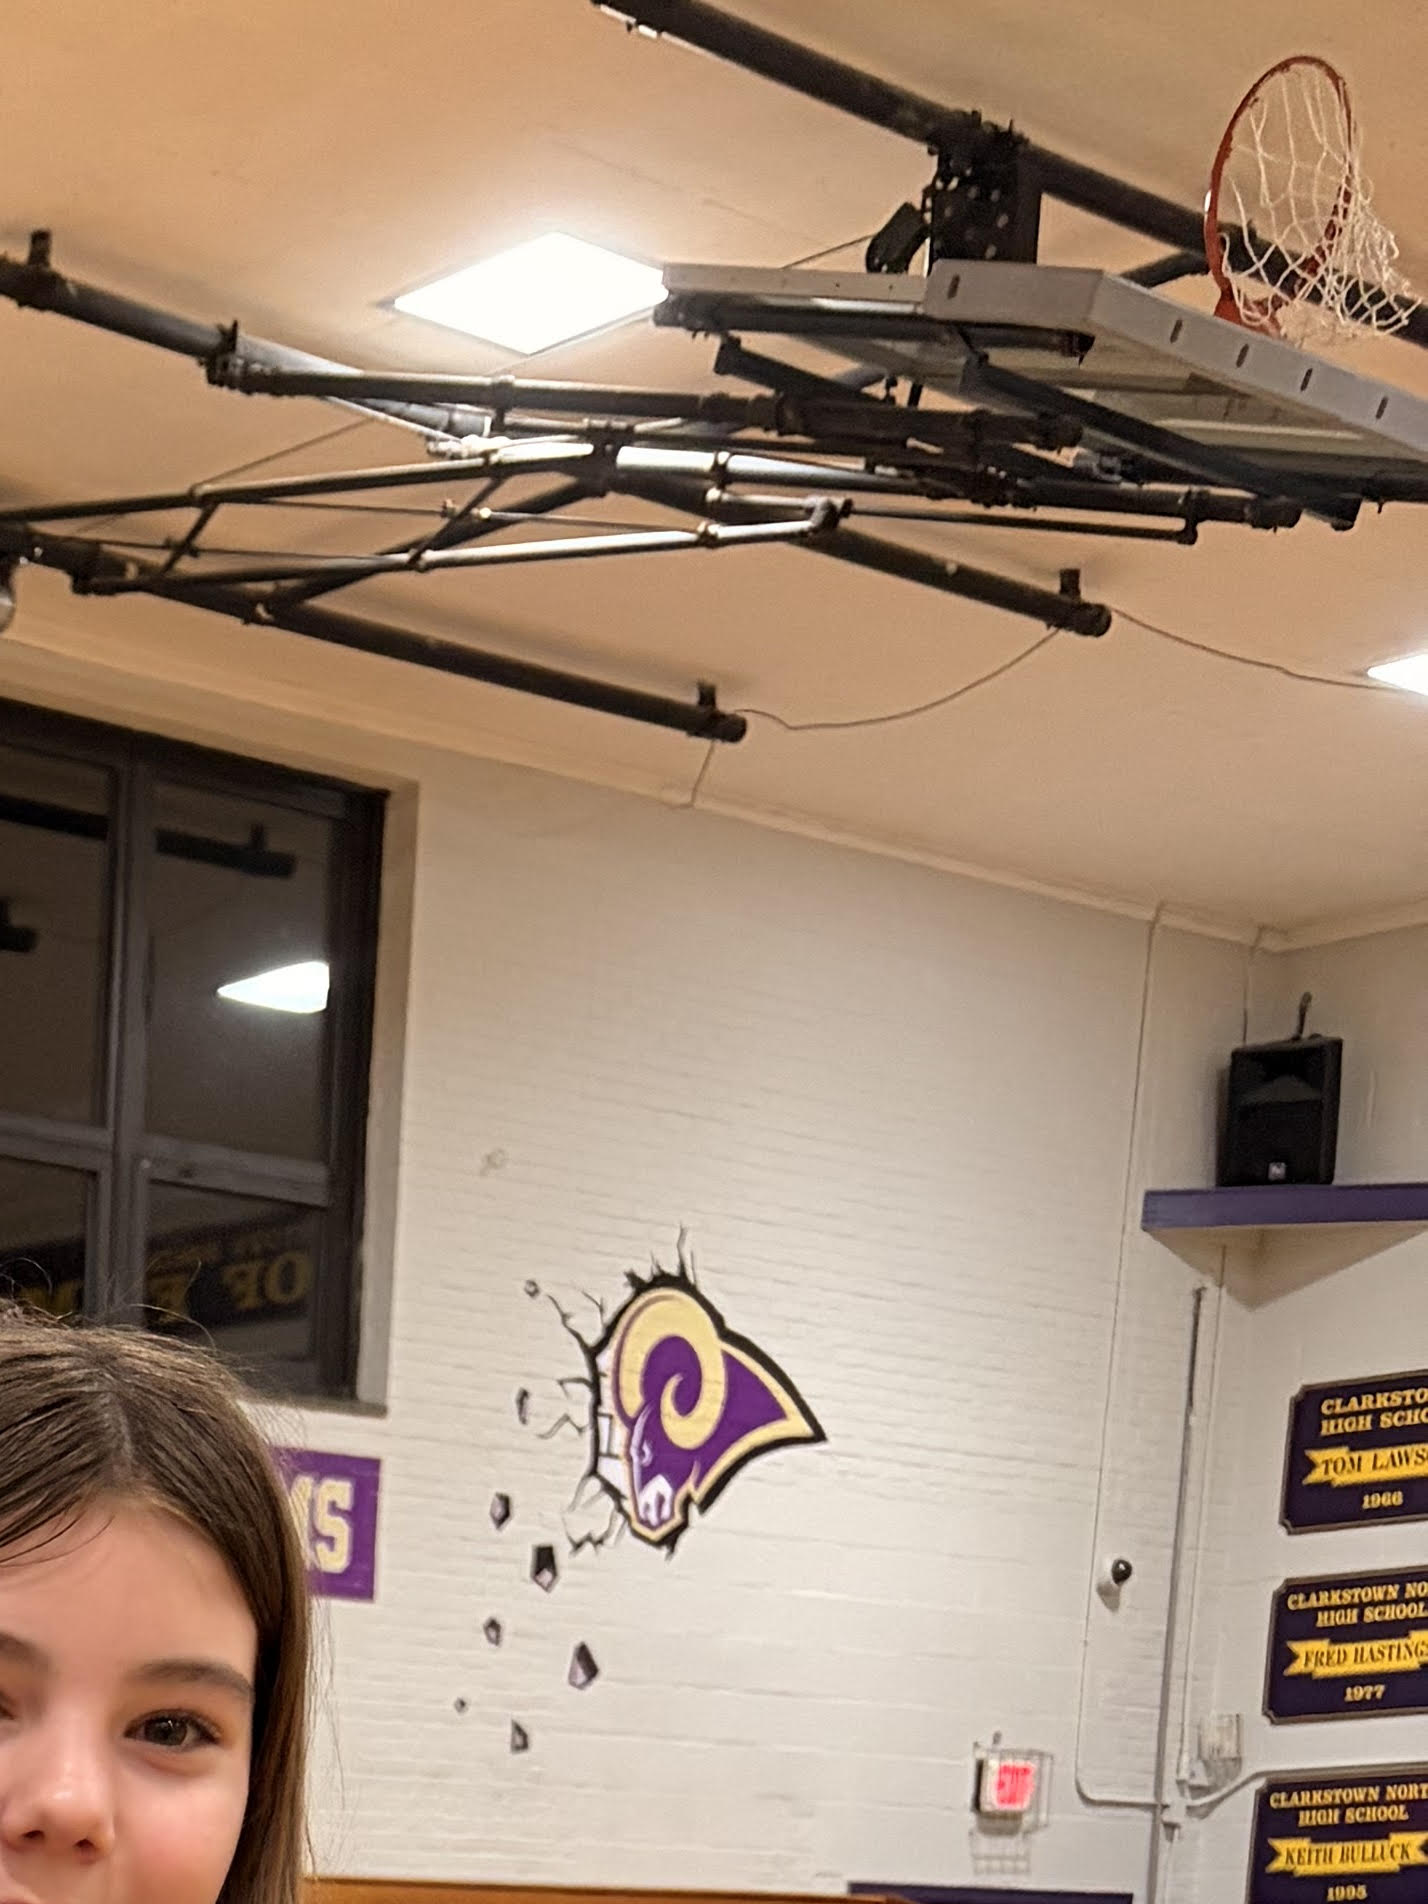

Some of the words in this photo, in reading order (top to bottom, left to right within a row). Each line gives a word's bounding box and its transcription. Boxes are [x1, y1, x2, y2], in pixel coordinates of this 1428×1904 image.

[1320, 1414, 1373, 1436] HIGH
[1321, 1455, 1362, 1476] TOM
[1372, 1448, 1428, 1473] LAWS
[1287, 1584, 1400, 1610] CLARKSTOWN
[1316, 1608, 1359, 1627] HIGH
[1363, 1602, 1428, 1623] SCHOOL
[1303, 1647, 1348, 1668] FRED
[1353, 1640, 1428, 1666] HASTING
[1344, 1683, 1386, 1702] 1977
[1270, 1786, 1380, 1809] CLARKSTOWN
[1298, 1808, 1340, 1827] HIGH
[1345, 1804, 1409, 1824] SCHOOL
[1285, 1846, 1333, 1866] KEITH
[1339, 1842, 1411, 1865] BULLUCK
